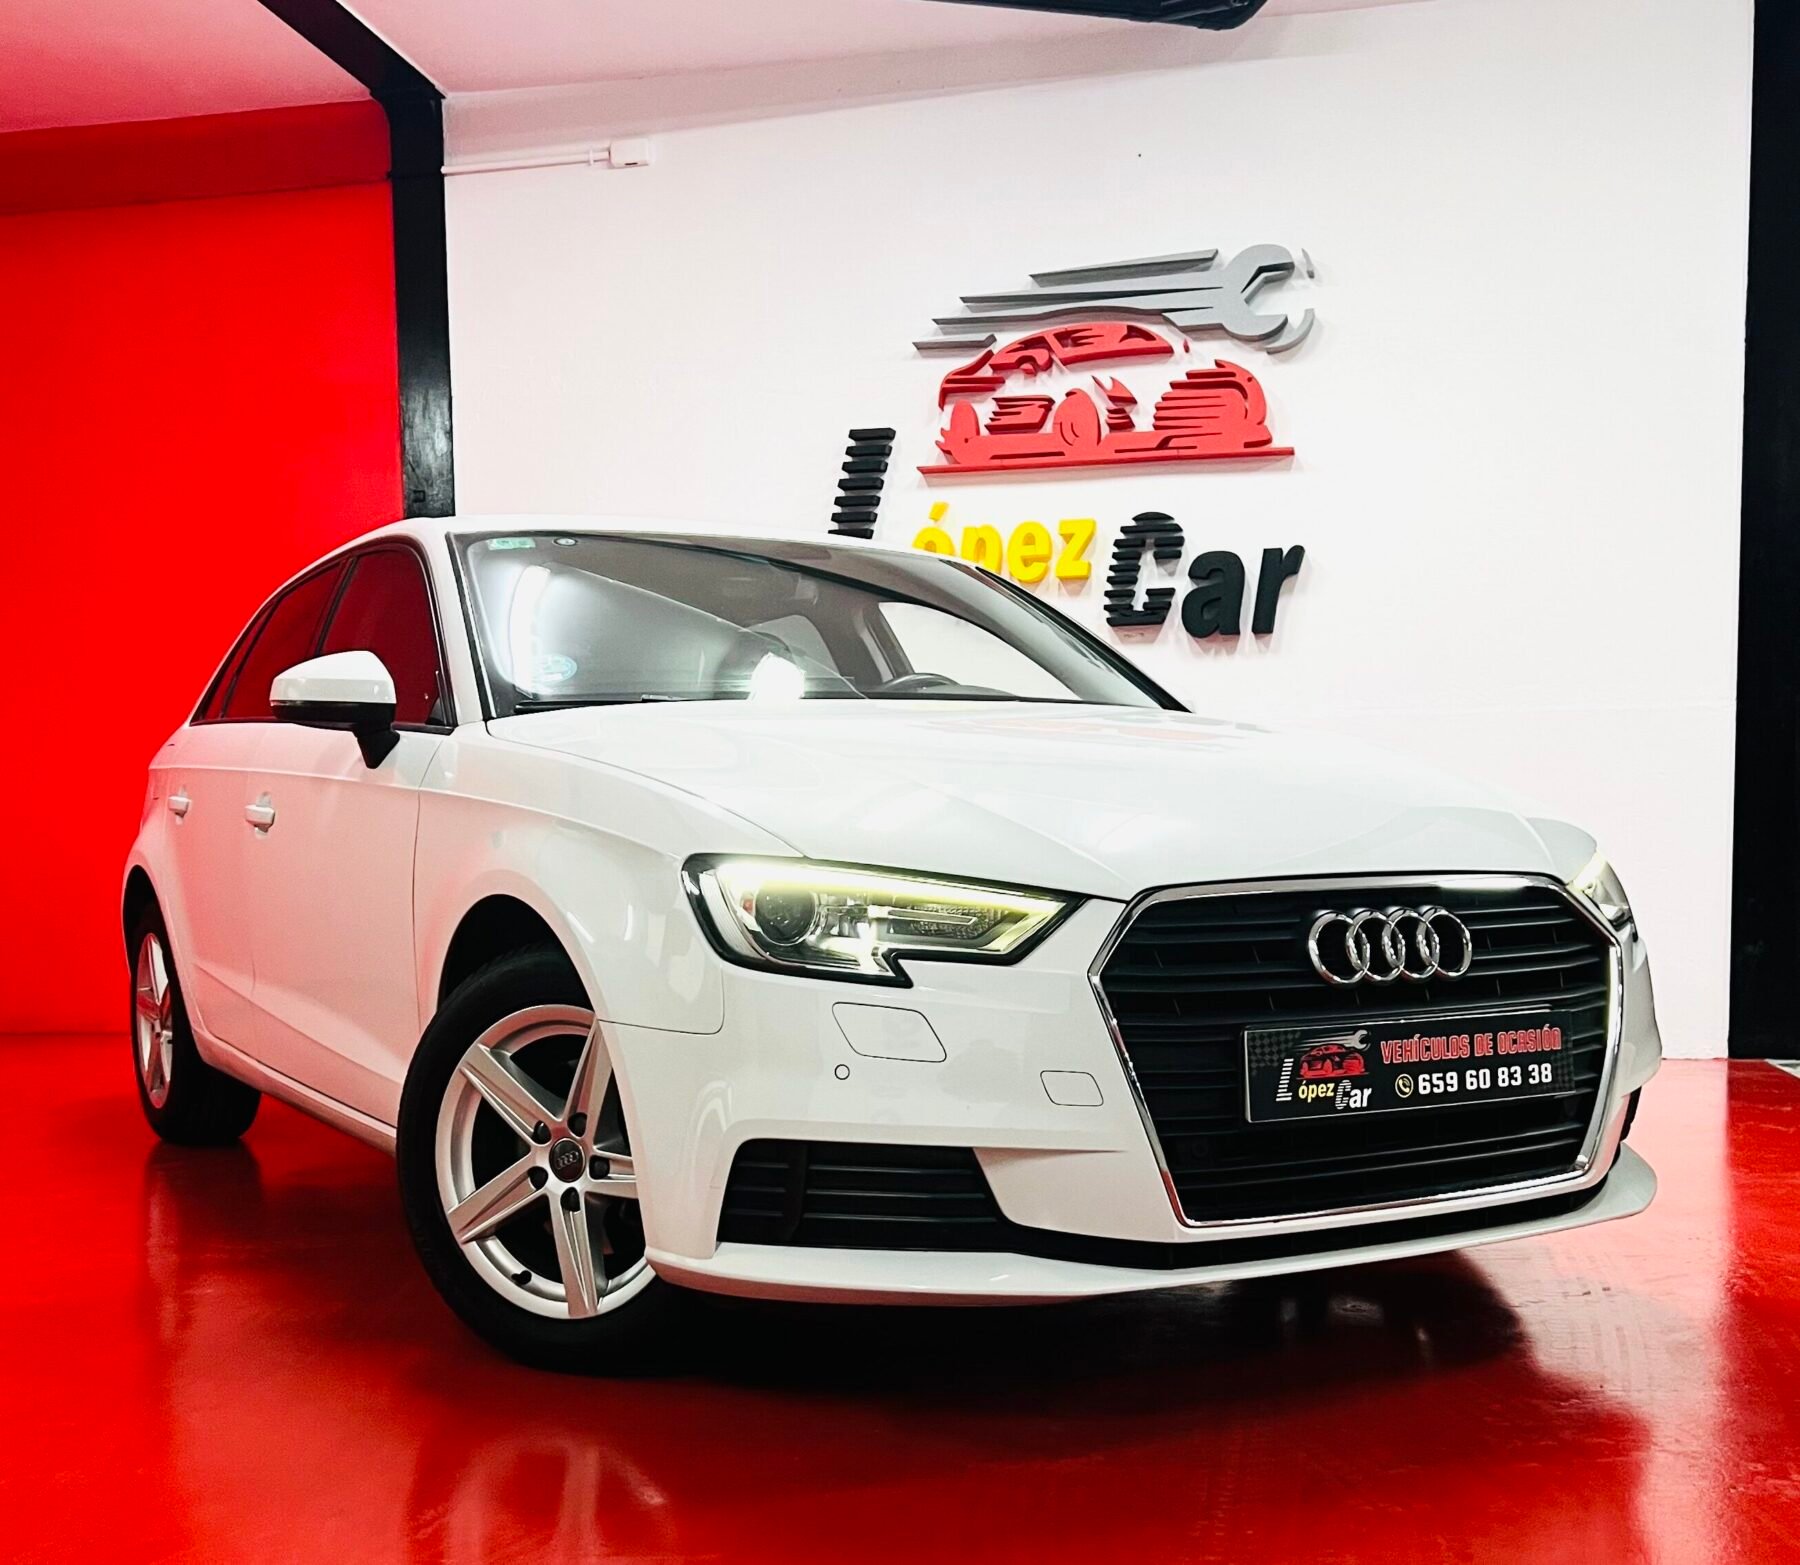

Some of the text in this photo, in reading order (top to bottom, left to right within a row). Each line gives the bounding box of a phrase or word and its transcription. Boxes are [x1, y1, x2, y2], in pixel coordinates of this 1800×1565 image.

[1103, 511, 1306, 638] Car
[1380, 1023, 1562, 1064] VEHÍCULOS DE OCASIÓN
[1275, 1058, 1372, 1110] López Car
[1418, 1062, 1553, 1095] 659 60 83 38
